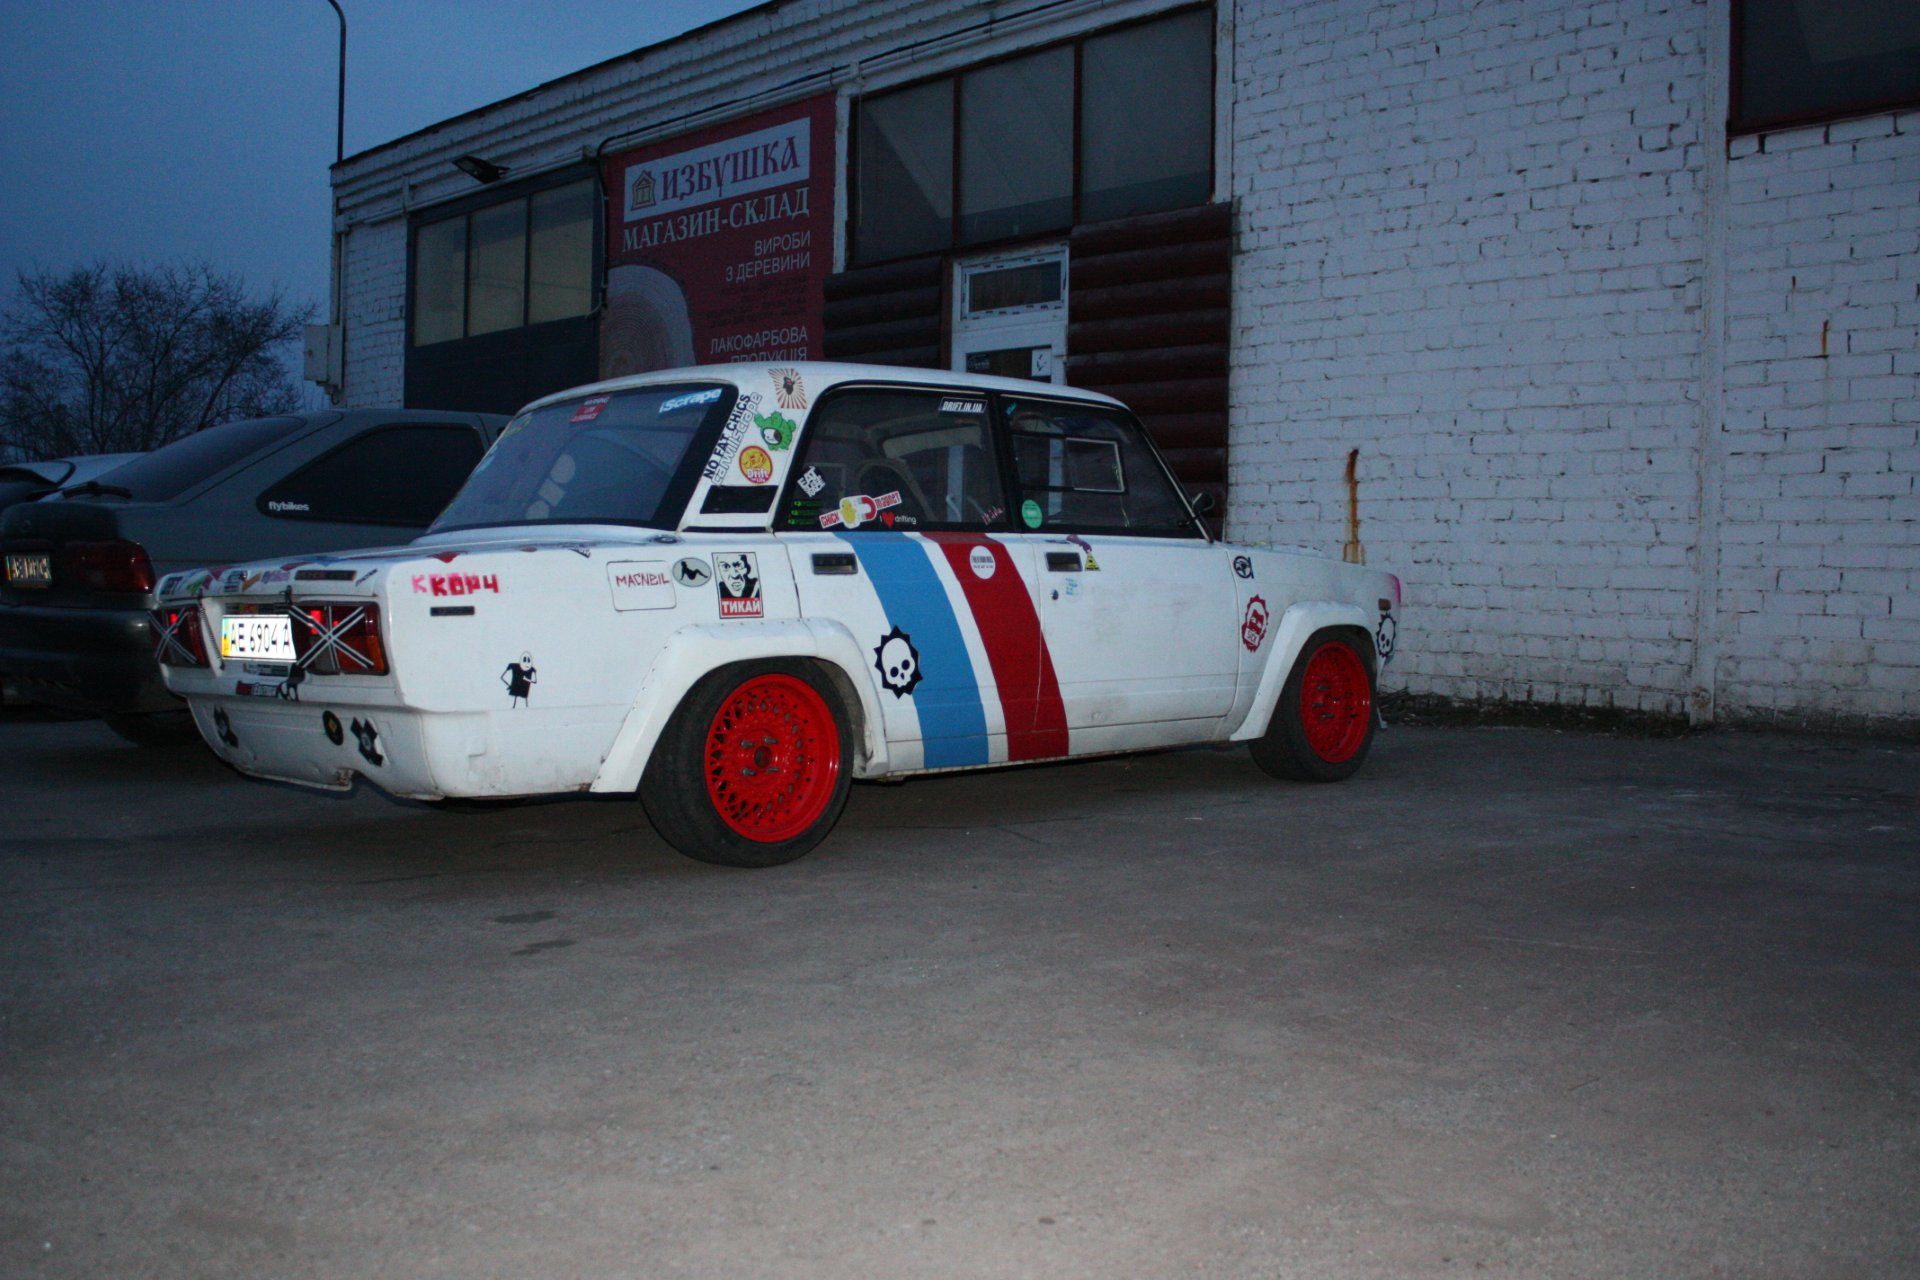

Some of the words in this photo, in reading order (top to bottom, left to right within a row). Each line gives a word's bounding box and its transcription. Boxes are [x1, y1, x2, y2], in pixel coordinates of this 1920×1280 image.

[661, 136, 801, 201] ИЗБУШКА
[621, 187, 811, 252] МАГАЗИН-СКЛАД
[754, 230, 811, 256] ВИРОБИ
[735, 251, 811, 284] ДЕРЕВИНИ
[709, 325, 809, 355] ЛАКОФАРБОВА
[703, 459, 720, 479] NO
[715, 433, 732, 457] FAT
[268, 501, 310, 511] flybikes
[894, 513, 917, 525] drifting
[721, 598, 762, 614] ТИКАЙ
[231, 623, 245, 652] AE
[250, 623, 278, 653] 6904
